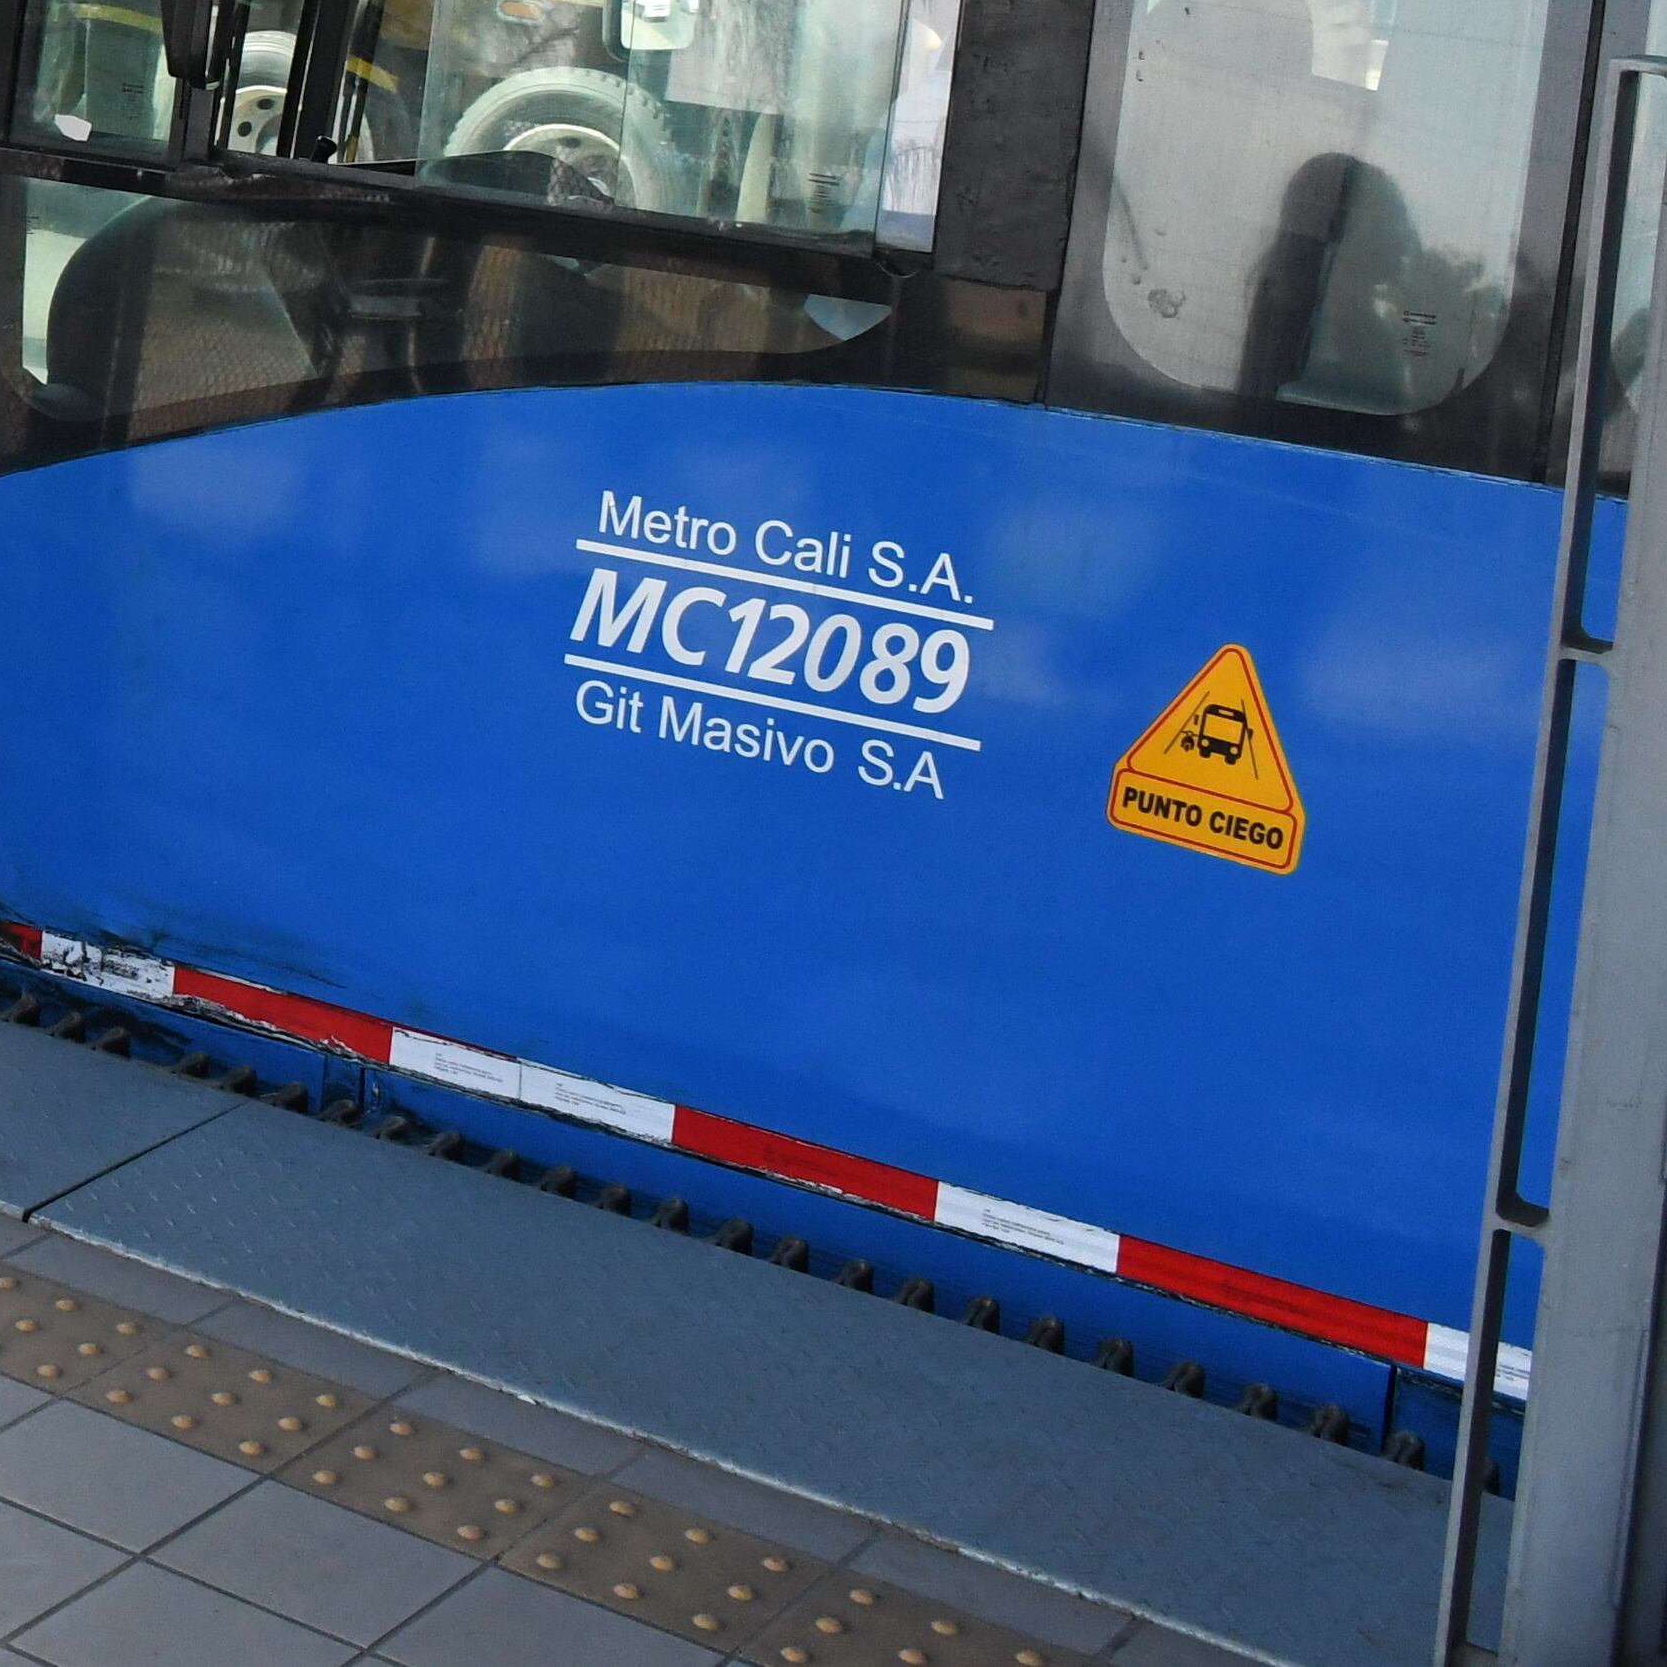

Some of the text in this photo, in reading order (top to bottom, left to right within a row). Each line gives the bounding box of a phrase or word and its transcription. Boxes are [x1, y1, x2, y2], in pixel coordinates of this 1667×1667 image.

[598, 489, 974, 605] Metro Cali S.A.
[569, 567, 971, 714] MC12089
[575, 679, 945, 801] Git Masivo S.A
[1122, 786, 1284, 850] PUNTO CIEGO
